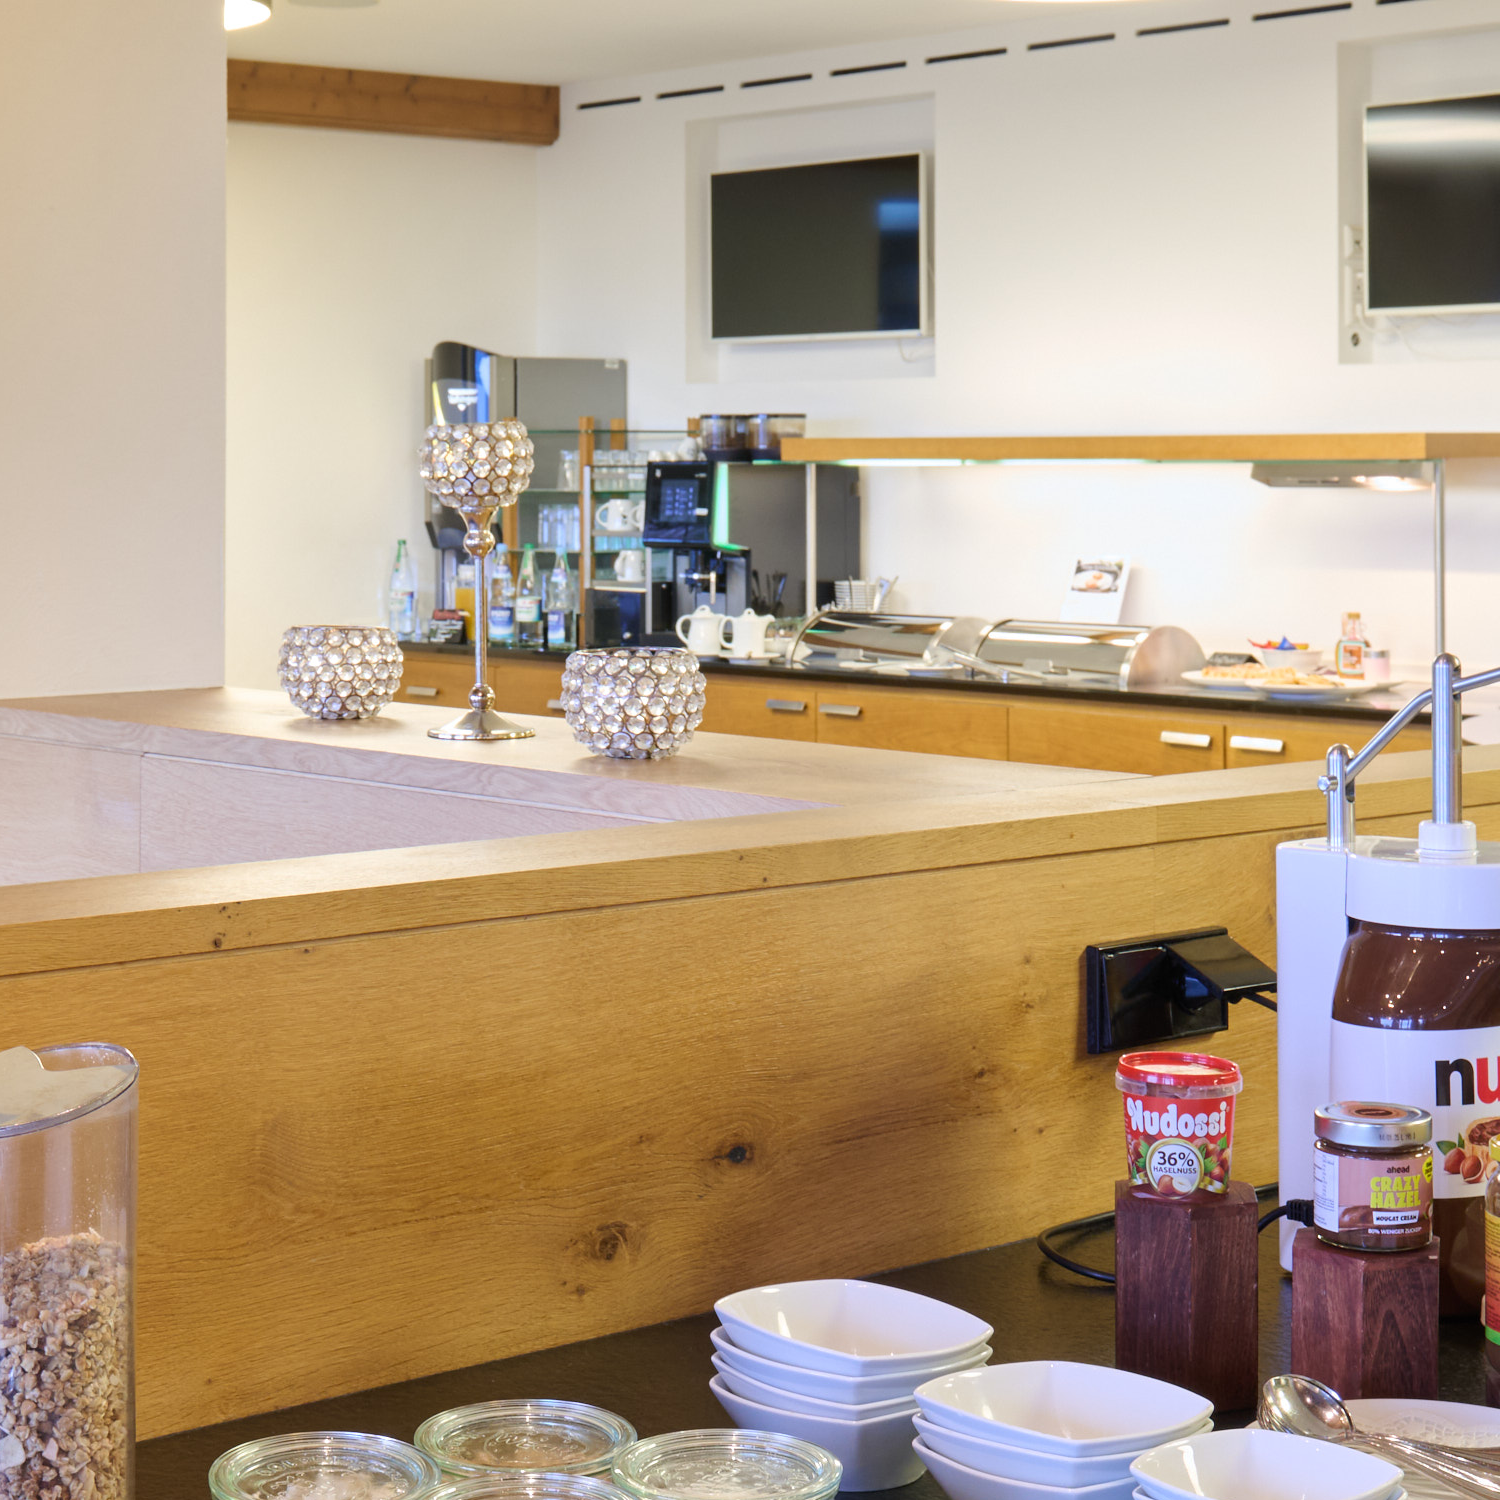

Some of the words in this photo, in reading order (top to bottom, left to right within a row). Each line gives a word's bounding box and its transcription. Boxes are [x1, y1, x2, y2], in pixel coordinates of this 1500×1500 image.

[1126, 1097, 1227, 1138] Nudossi
[1157, 1151, 1194, 1168] 36%
[1153, 1165, 1197, 1175] HASELNUSS
[1386, 1165, 1411, 1174] ahead
[1370, 1174, 1421, 1192] CRAZY
[1370, 1190, 1421, 1209] HAZEL
[1400, 1214, 1417, 1222] CREAM
